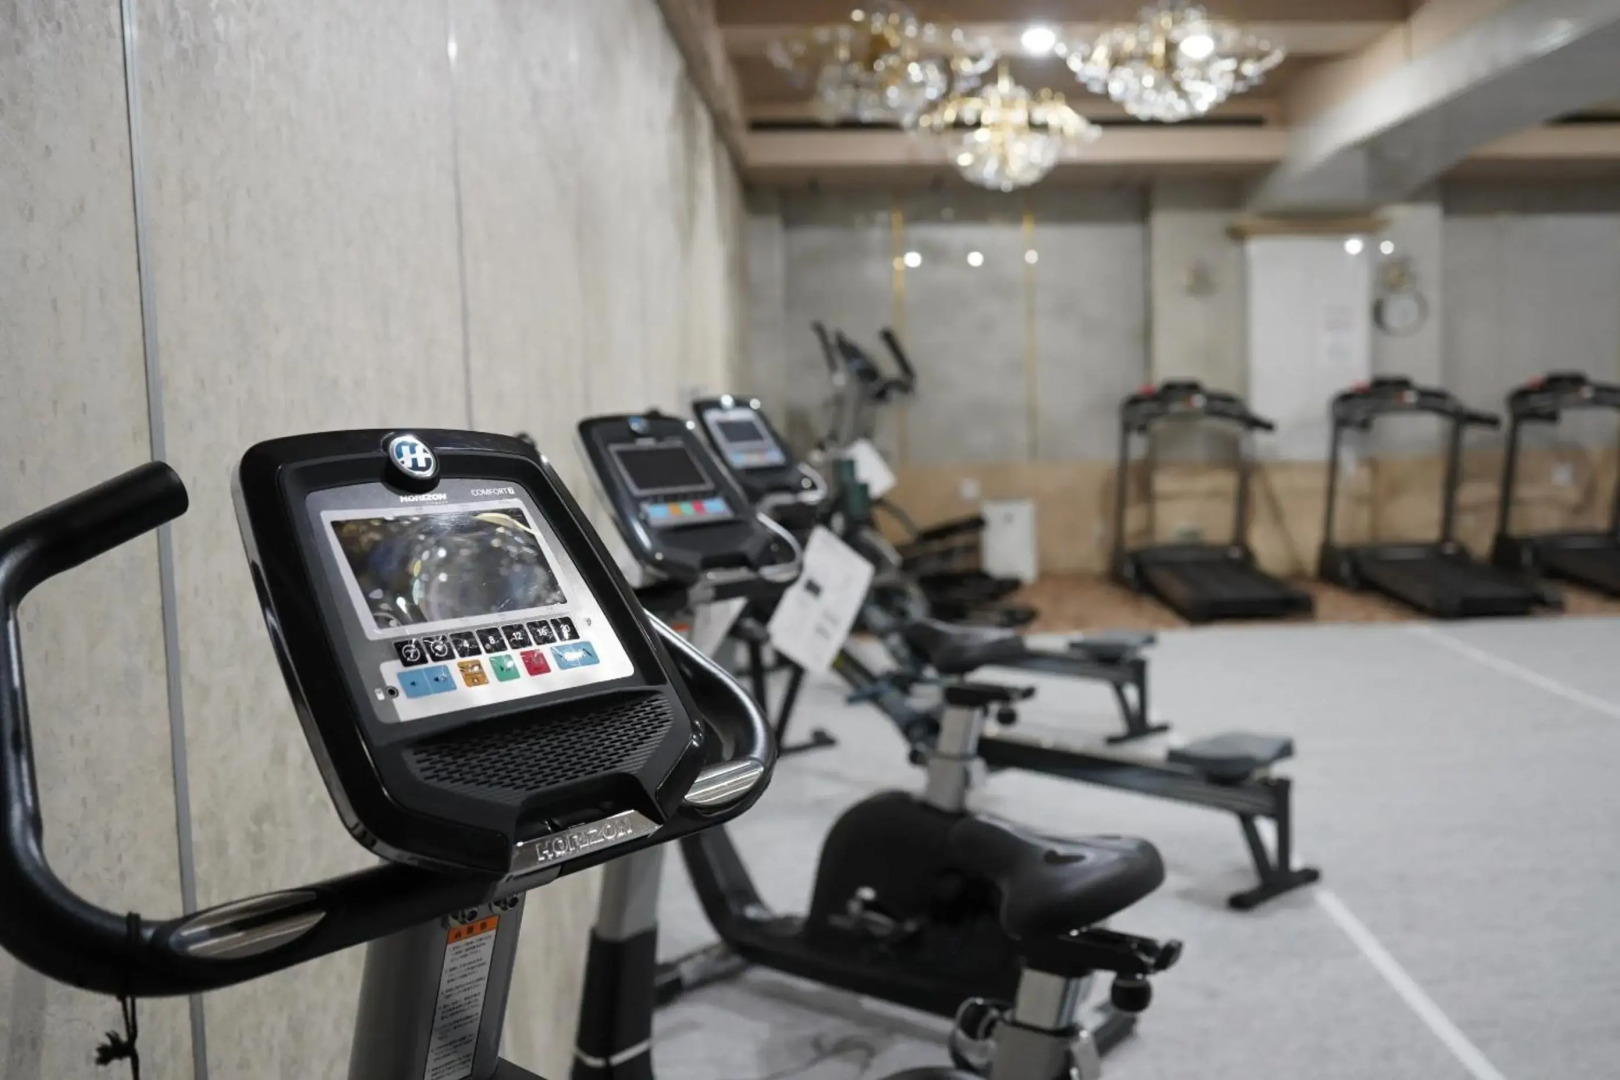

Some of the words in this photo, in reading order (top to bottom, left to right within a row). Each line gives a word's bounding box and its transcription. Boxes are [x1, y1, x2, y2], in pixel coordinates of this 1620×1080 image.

[399, 493, 447, 502] HORIZON
[512, 631, 523, 640] 12
[537, 625, 549, 637] 16
[536, 817, 633, 862] HORIZON
